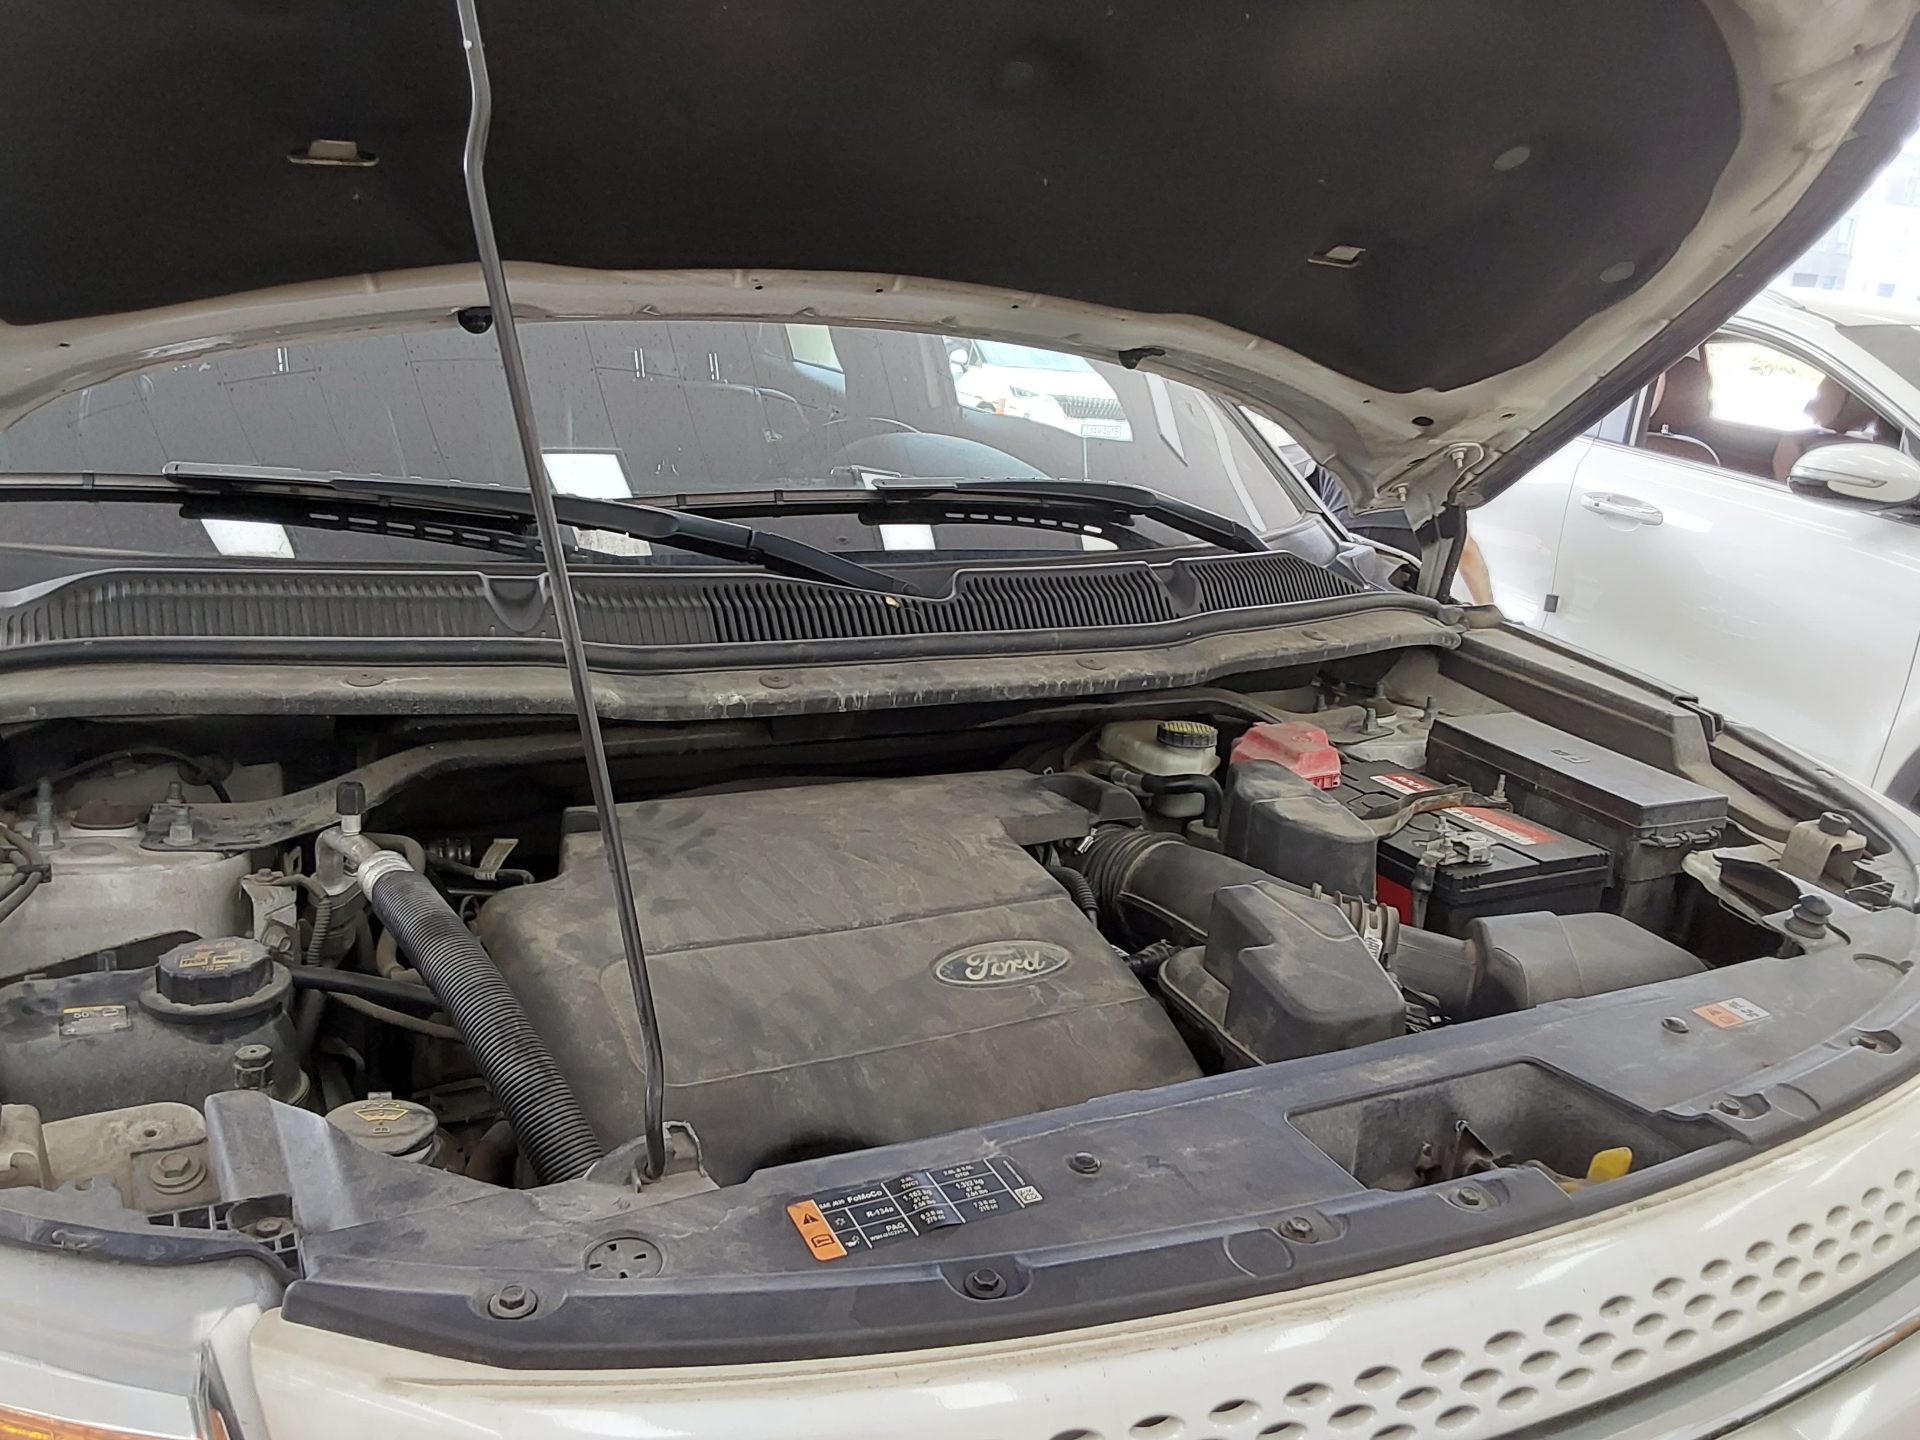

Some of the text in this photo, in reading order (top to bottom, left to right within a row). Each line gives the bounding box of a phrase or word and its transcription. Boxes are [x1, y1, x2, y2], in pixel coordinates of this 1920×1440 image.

[965, 947, 1046, 980] Ford
[847, 1190, 883, 1204] FoMoCo
[866, 1206, 895, 1218] R-134a
[885, 1221, 905, 1232] PAG
